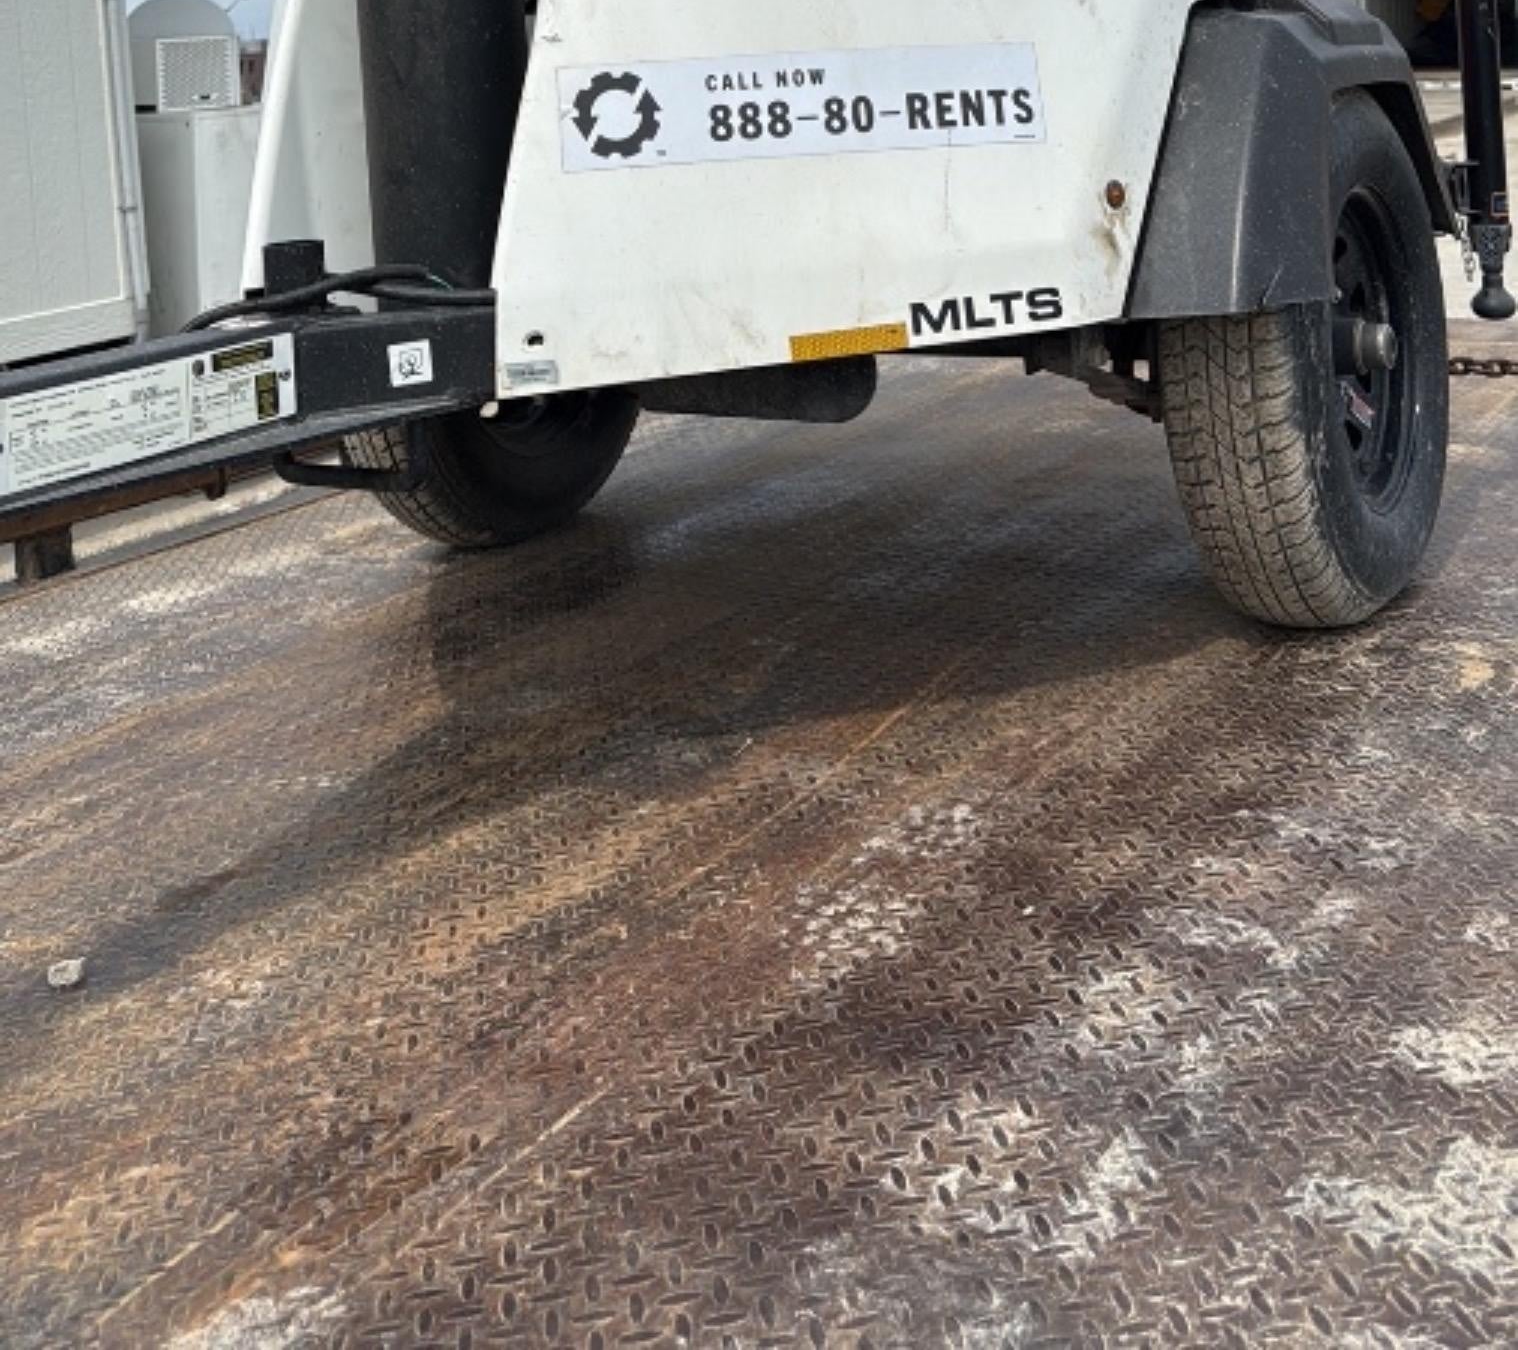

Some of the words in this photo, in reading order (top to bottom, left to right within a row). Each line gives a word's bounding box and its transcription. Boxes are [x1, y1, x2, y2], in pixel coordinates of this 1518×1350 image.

[704, 74, 764, 92] CALL
[776, 68, 826, 87] NOW
[709, 87, 1035, 142] 888-80-RENTS
[910, 287, 1063, 335] MLTS
